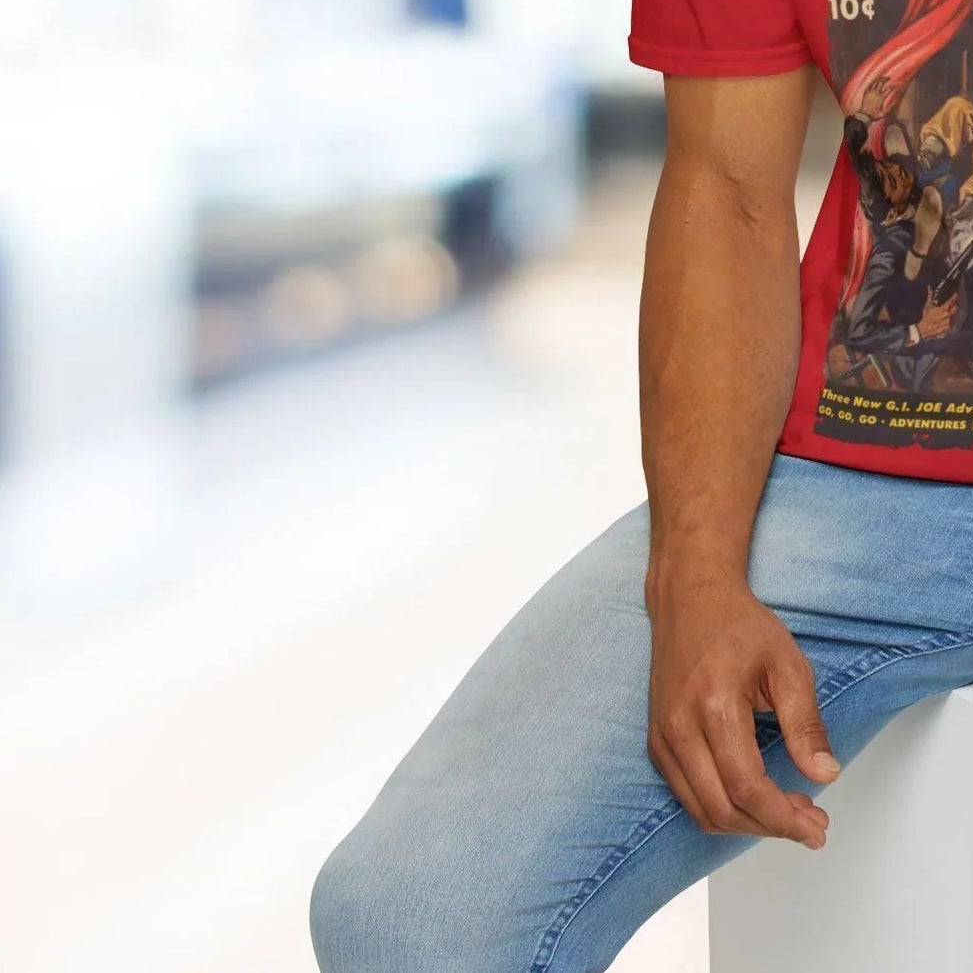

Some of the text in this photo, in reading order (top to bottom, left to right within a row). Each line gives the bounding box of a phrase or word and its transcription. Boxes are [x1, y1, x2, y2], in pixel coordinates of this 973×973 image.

[822, 389, 850, 404] Three
[853, 396, 882, 409] New
[916, 402, 943, 413] JOE
[818, 405, 835, 418] GO,
[838, 411, 855, 424] GO,
[859, 415, 877, 425] GO
[889, 418, 966, 430] ADVENTURES
